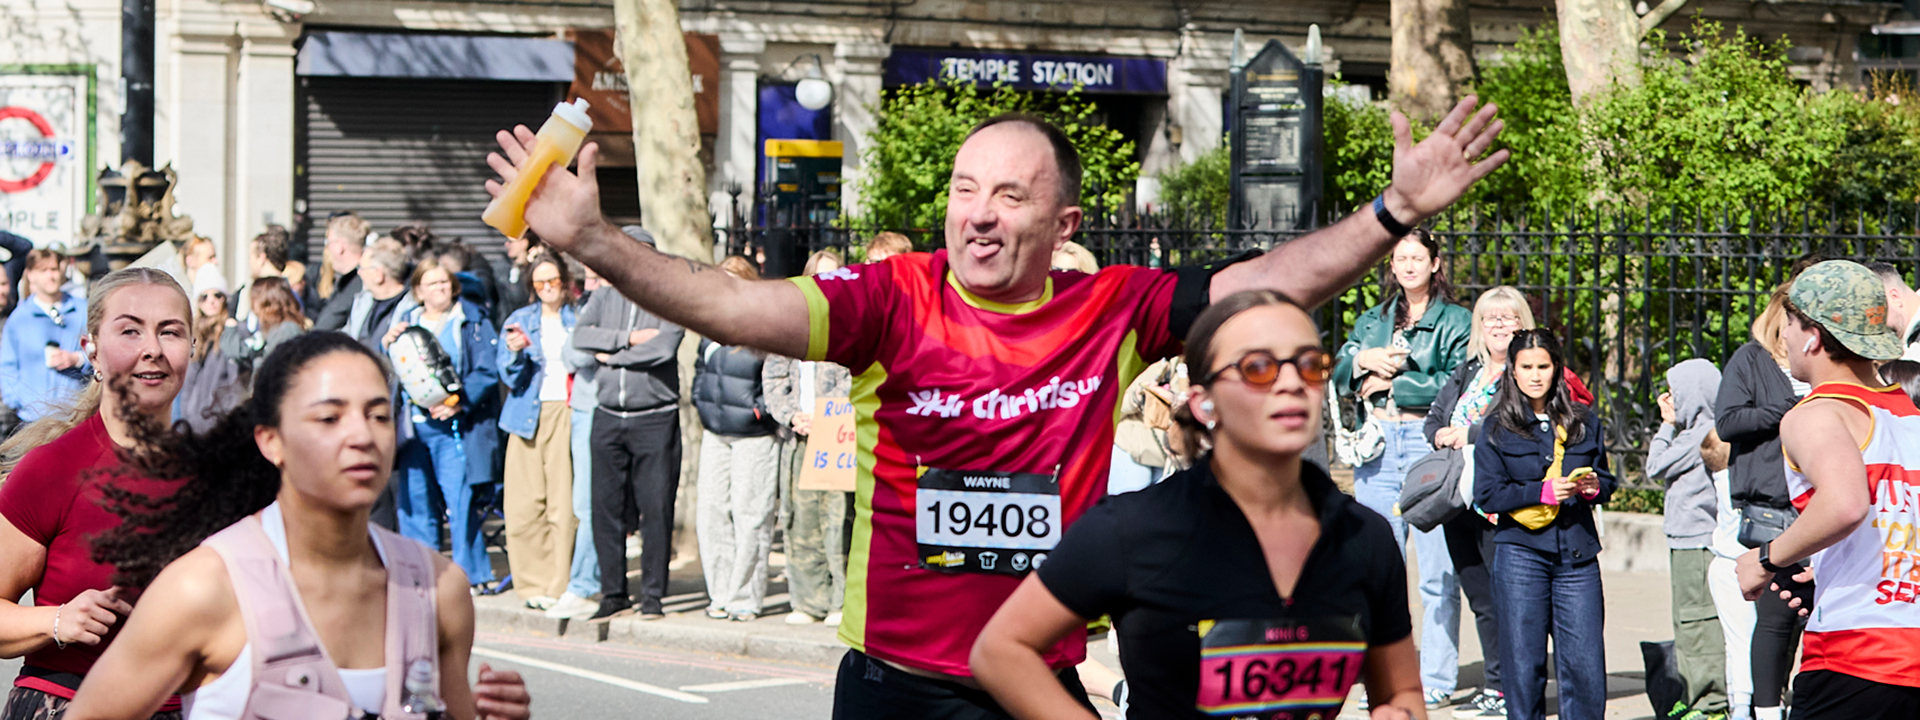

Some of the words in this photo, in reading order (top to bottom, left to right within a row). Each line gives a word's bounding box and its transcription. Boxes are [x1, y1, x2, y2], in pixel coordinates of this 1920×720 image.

[944, 57, 1020, 82] TEMPLE
[1032, 60, 1113, 85] STATION
[963, 476, 1012, 489] WAYNE
[927, 501, 1051, 538] 19408
[1214, 656, 1349, 699] 16341
